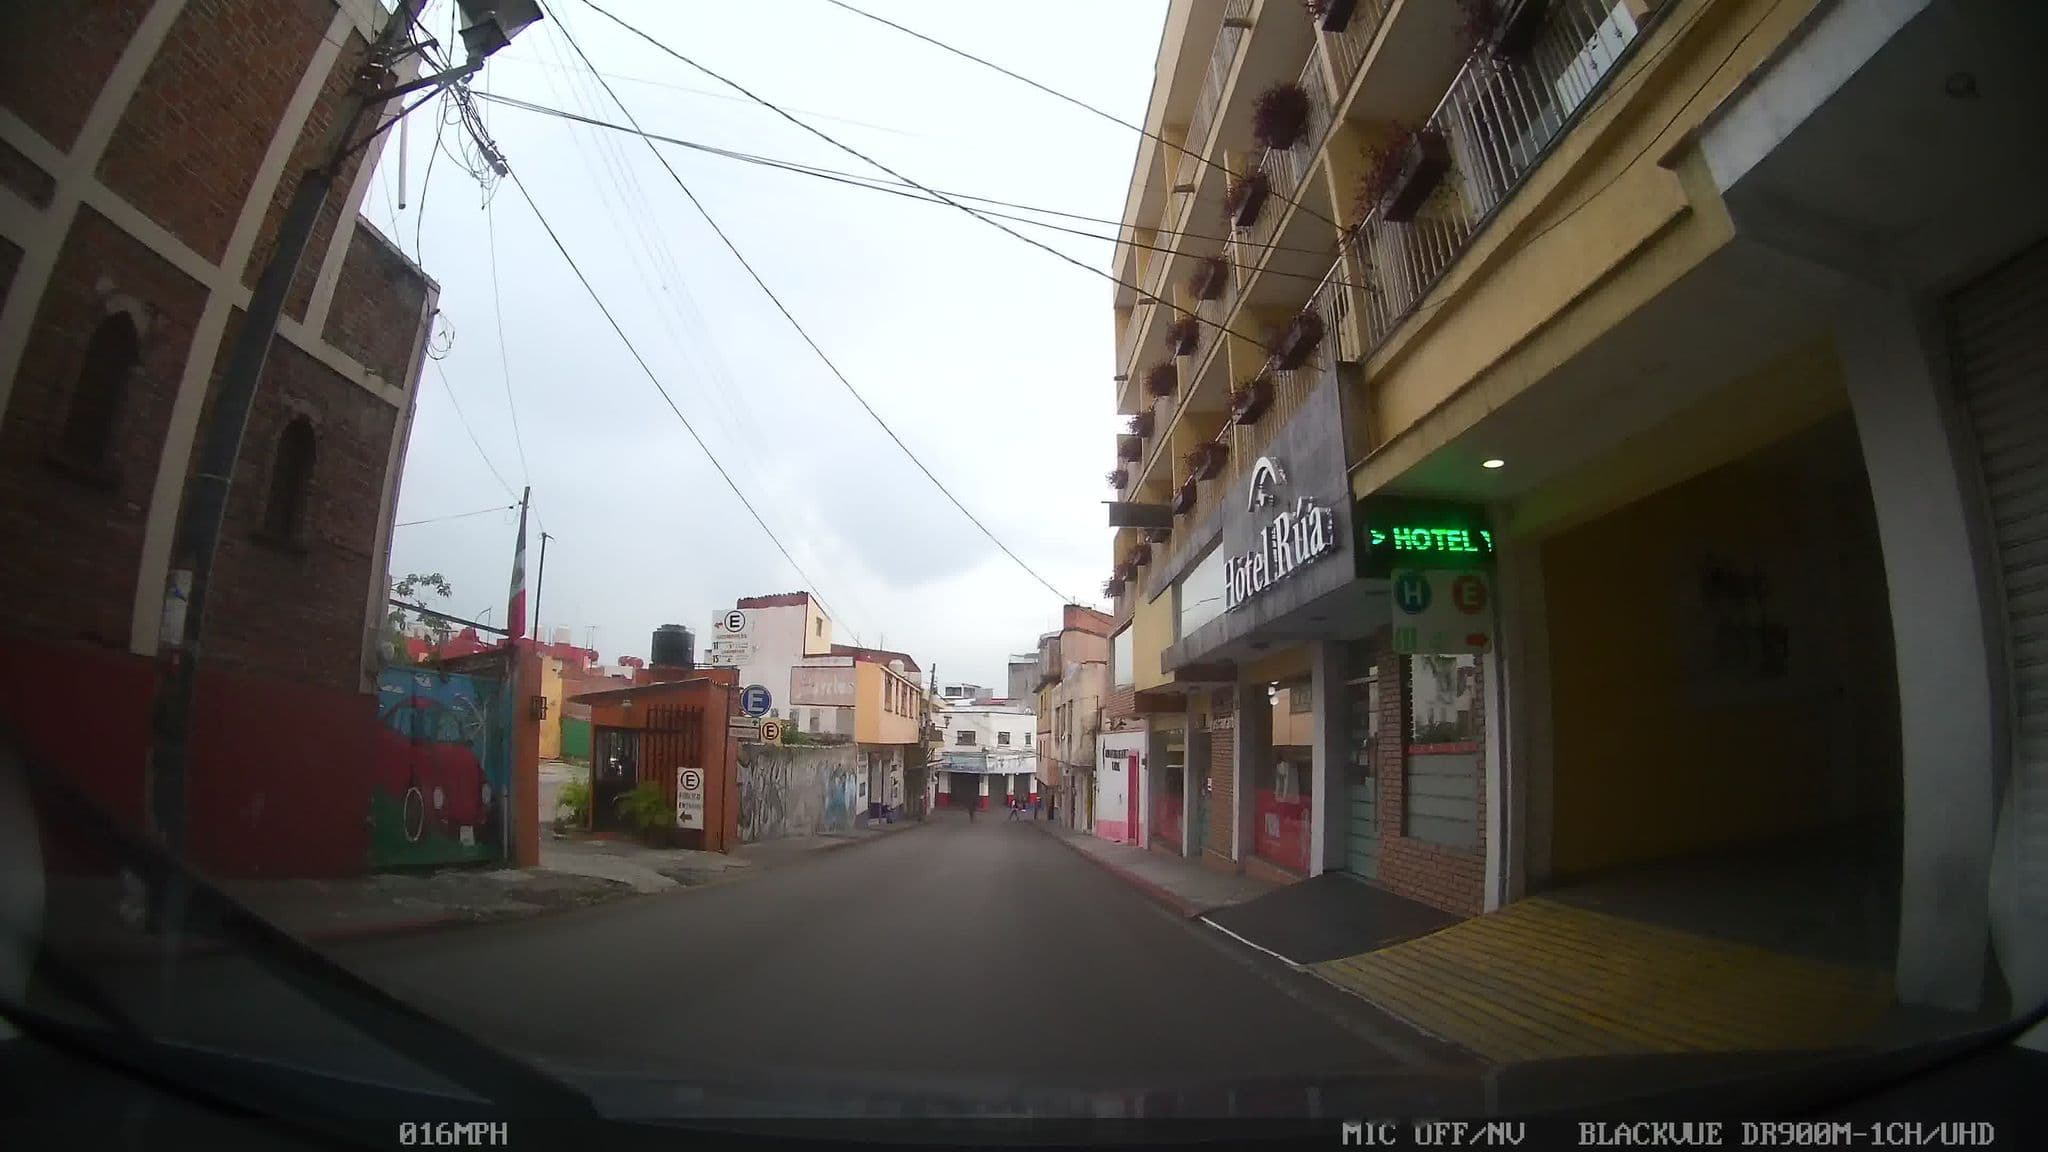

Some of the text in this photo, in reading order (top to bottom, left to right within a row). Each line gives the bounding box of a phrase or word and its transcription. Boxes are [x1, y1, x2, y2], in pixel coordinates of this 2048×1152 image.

[1391, 527, 1480, 552] HOTEL
[1224, 495, 1329, 613] Hotel Rúa
[1403, 580, 1423, 606] H
[729, 614, 741, 628] E
[747, 689, 765, 712] E
[766, 725, 775, 738] E
[685, 774, 695, 787] E
